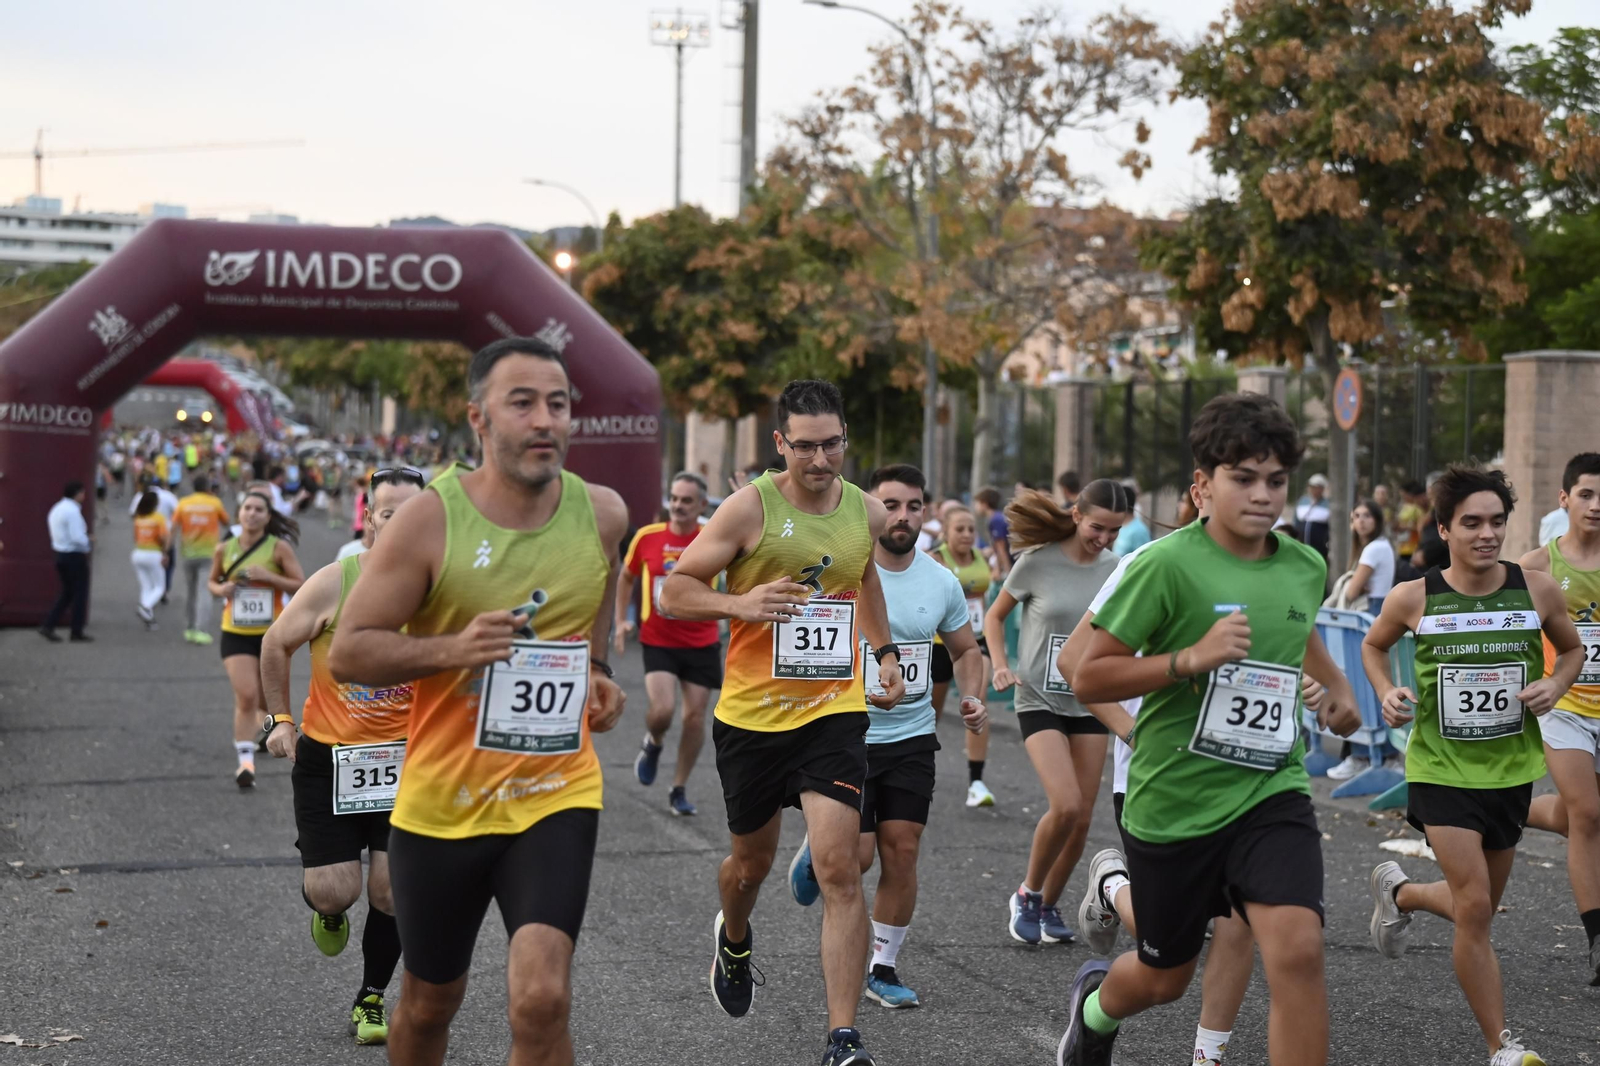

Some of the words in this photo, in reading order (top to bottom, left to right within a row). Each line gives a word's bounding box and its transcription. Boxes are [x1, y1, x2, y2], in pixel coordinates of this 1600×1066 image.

[265, 250, 463, 293] IMDECO
[10, 403, 93, 428] IMDECO
[581, 415, 659, 436] IMDECO
[241, 600, 264, 613] 301
[794, 626, 839, 651] 317
[1432, 643, 1480, 656] ATLETISMO
[1482, 640, 1529, 653] CORDOBÉS
[807, 666, 818, 675] 3k
[511, 680, 575, 714] 307
[1459, 689, 1509, 713] 326
[1226, 695, 1282, 732] 329
[524, 736, 539, 748] 3k
[1233, 747, 1248, 759] 3k
[352, 765, 398, 789] 315
[365, 800, 375, 808] 3k
